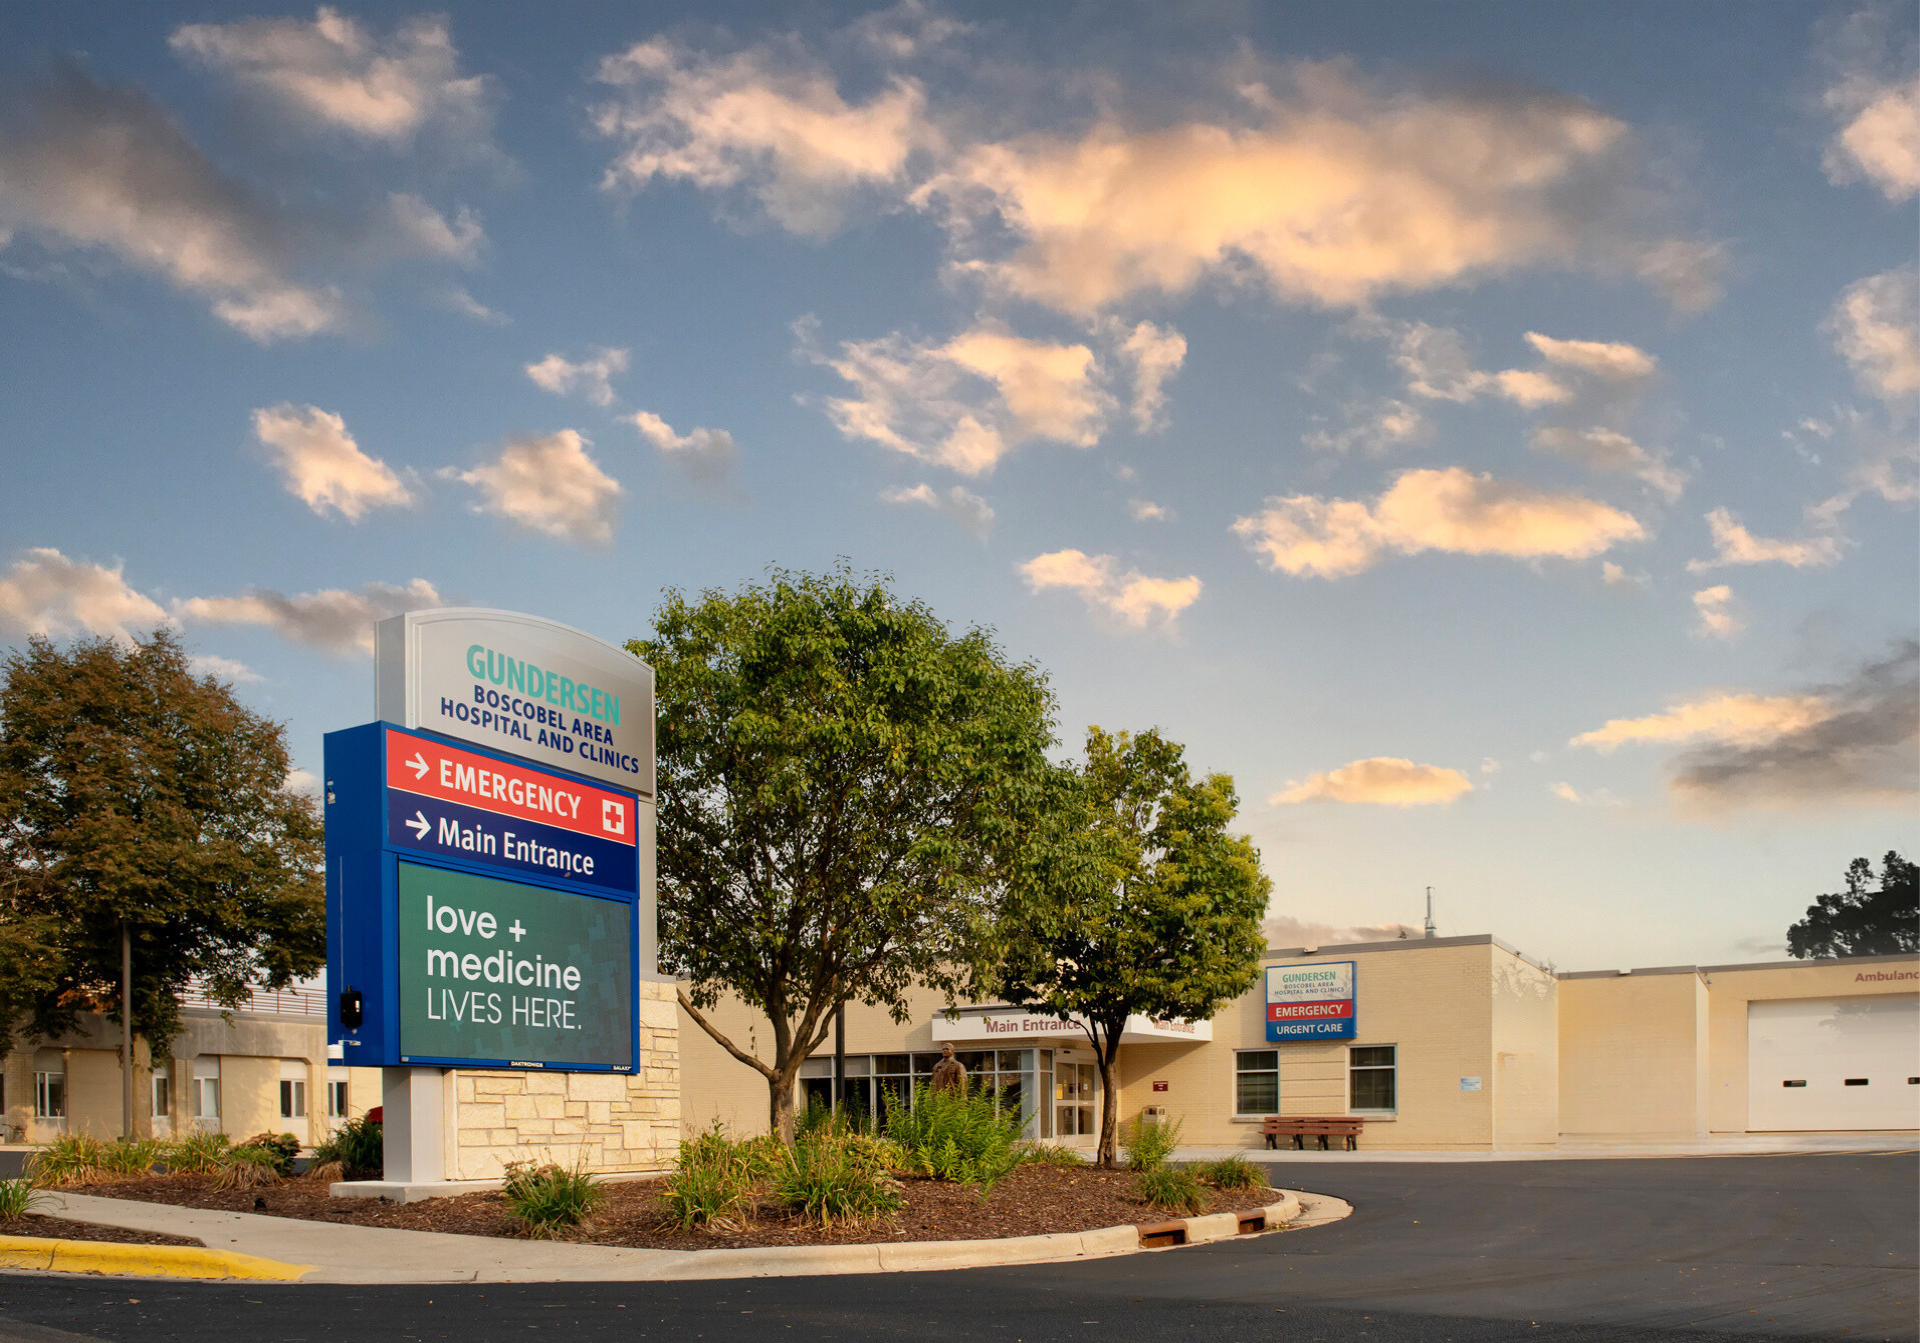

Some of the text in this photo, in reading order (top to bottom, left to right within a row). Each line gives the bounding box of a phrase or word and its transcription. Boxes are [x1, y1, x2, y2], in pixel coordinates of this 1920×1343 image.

[466, 644, 620, 726] GUNDERSEN
[441, 697, 639, 774] HOSPITAL AND CLINICS
[474, 685, 614, 746] BOSCOBEL AREA
[440, 758, 581, 819] EMERGENCY
[438, 817, 594, 875] Main Entrance
[427, 895, 497, 939] love
[427, 949, 581, 991] medicine
[1282, 971, 1336, 983] GUNDERSEN
[428, 988, 582, 1030] LIVES HERE.
[1274, 988, 1304, 996] HOSPITAL
[1275, 1004, 1343, 1017] EMERGENCY
[986, 1019, 1081, 1033] Main Entrance
[1277, 1023, 1343, 1034] URGENT CARE
